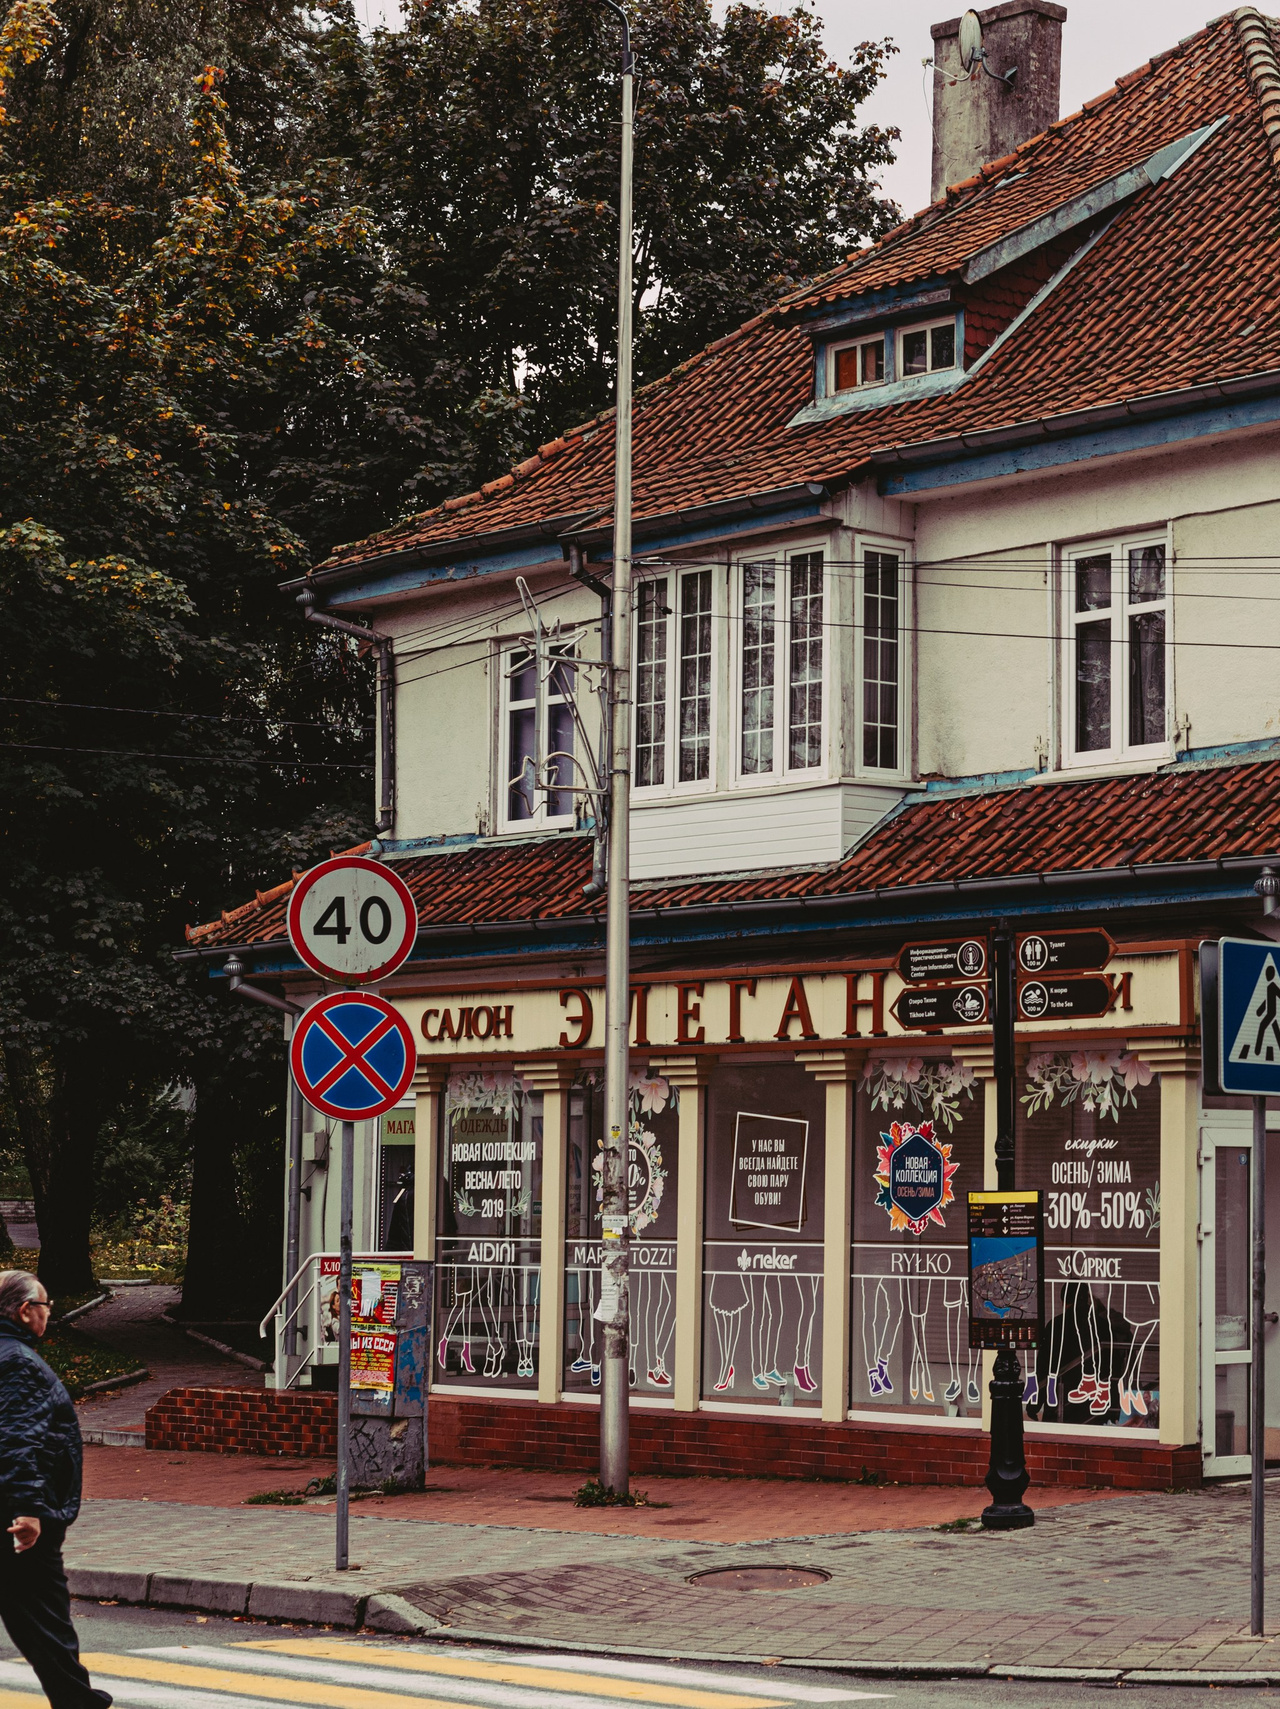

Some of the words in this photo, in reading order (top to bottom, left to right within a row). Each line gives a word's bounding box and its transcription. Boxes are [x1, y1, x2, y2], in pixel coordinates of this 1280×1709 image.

[313, 896, 391, 945] 40
[910, 964, 928, 972] Tourism
[420, 1004, 514, 1041] САЛОН
[386, 1120, 415, 1134] МАГА
[452, 1143, 481, 1163] НОВАЯ
[482, 1141, 536, 1163] КОЛЛЕКЦИЯ
[752, 1140, 757, 1152] У
[758, 1139, 773, 1152] НАС
[774, 1139, 785, 1152] ВЫ
[1064, 1138, 1119, 1157] скидки
[739, 1156, 766, 1171] ВСЕГДА
[766, 1155, 799, 1171] НАЙДЕТЕ
[905, 1157, 928, 1170] НОВАЯ
[465, 1170, 522, 1190] ВЕСНА/ЛЕТО
[747, 1174, 769, 1188] СВОЮ
[770, 1174, 789, 1188] ПАРУ
[895, 1169, 938, 1184] КОЛЛЕКЦИЯ
[754, 1191, 782, 1205] ОБУВИ!
[896, 1186, 935, 1198] ОСЕНЬ/ЗИМА
[481, 1199, 504, 1218] 2019
[361, 1336, 373, 1349] ИЗ
[374, 1337, 395, 1353] СССР
